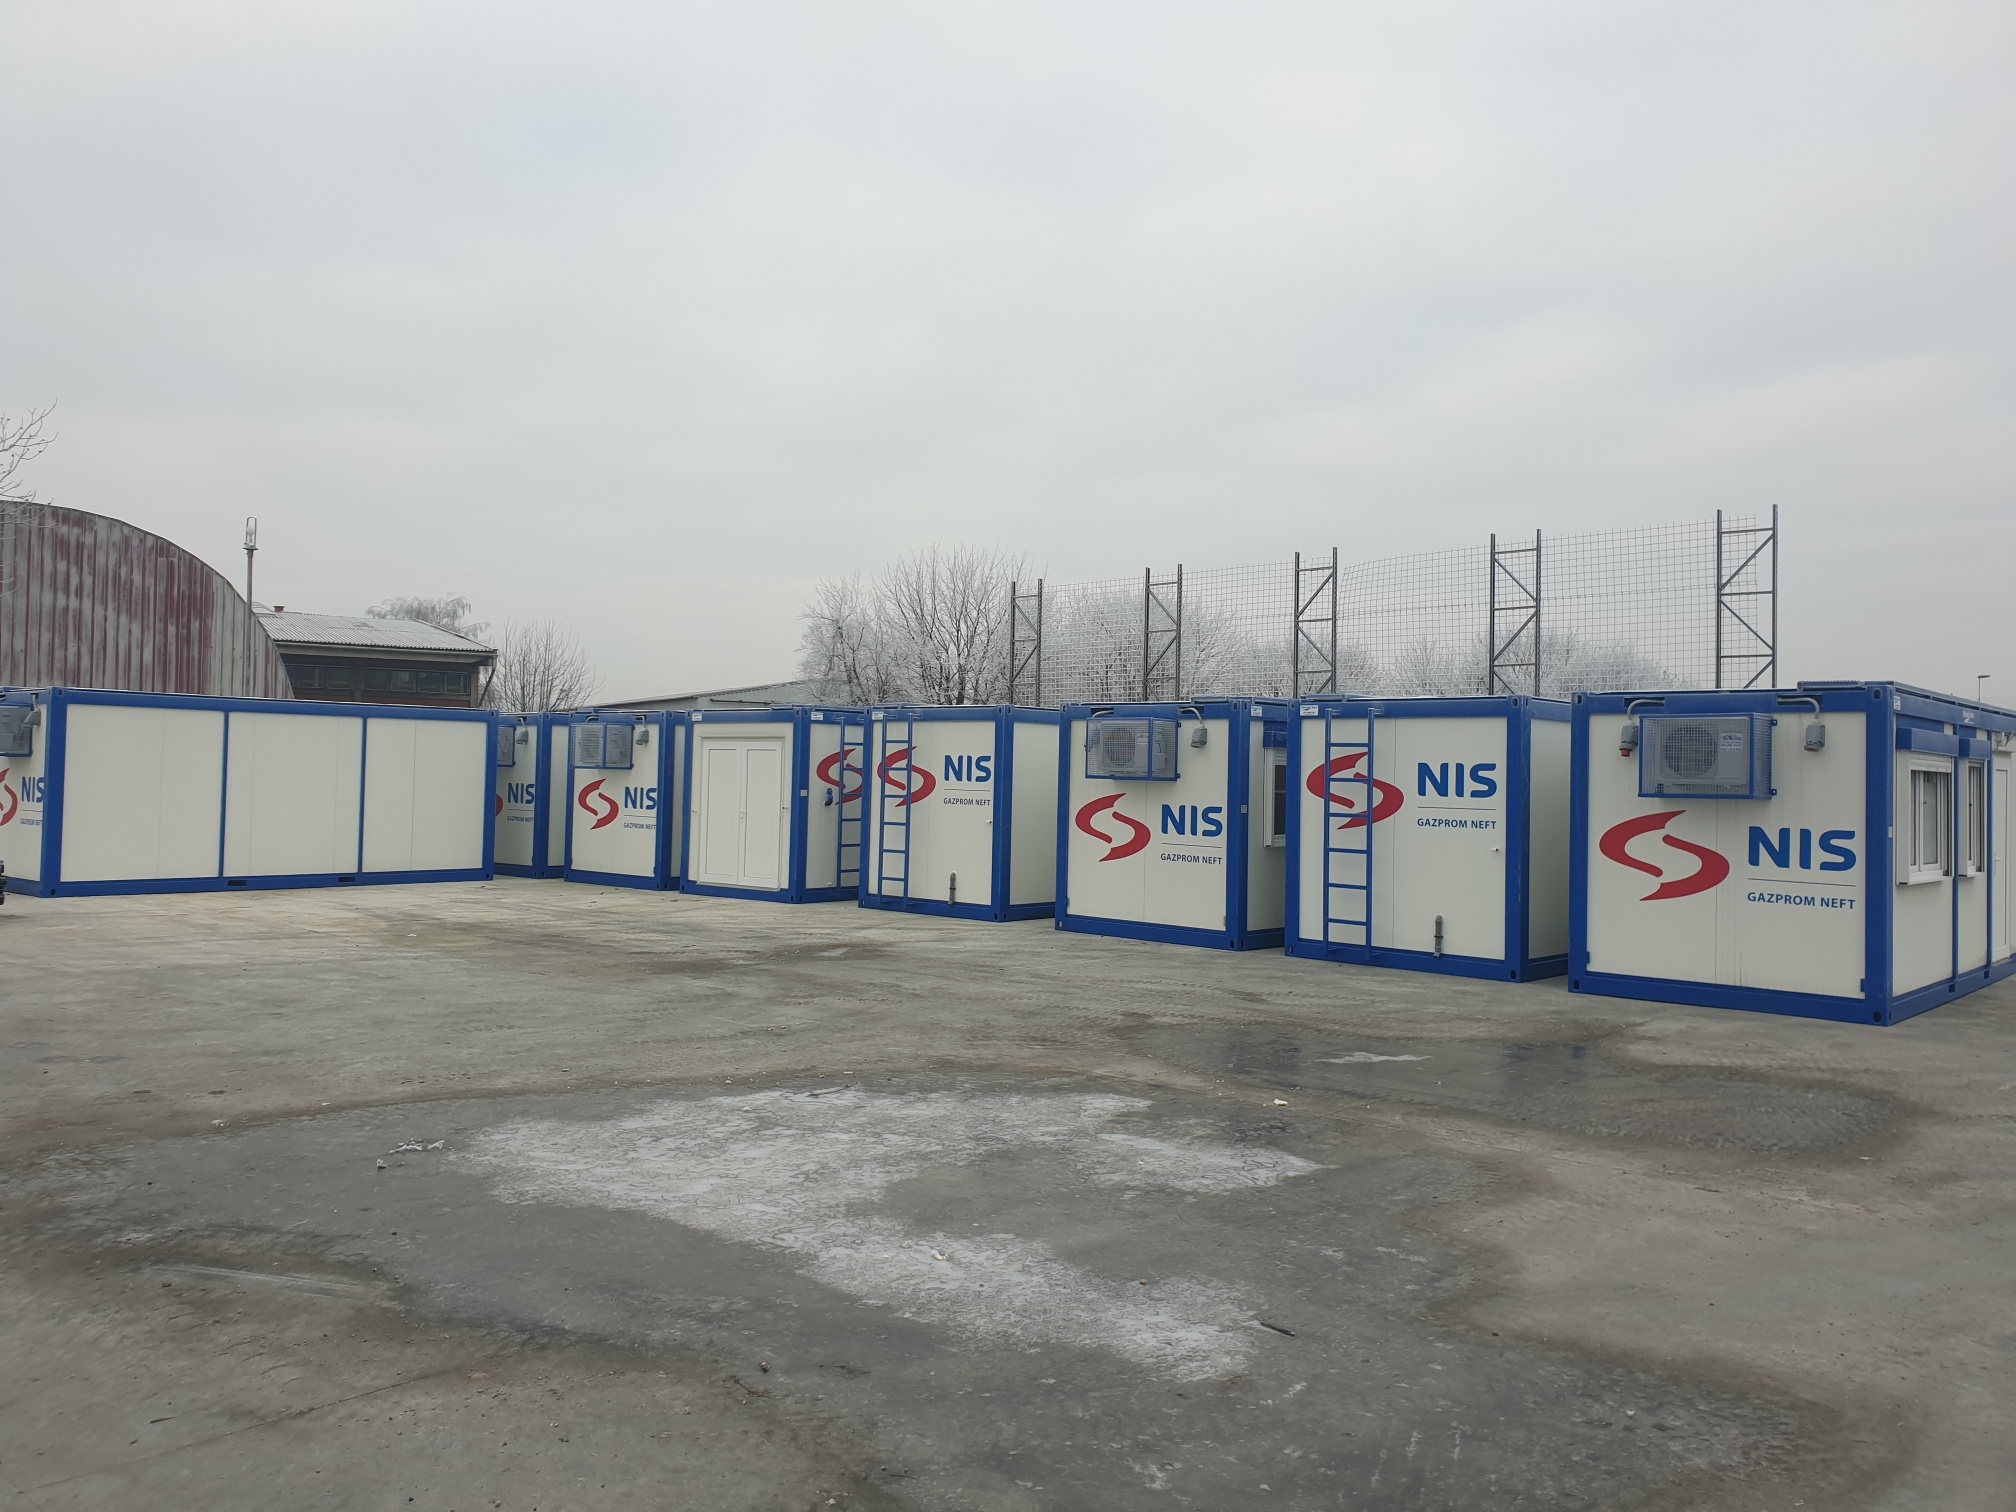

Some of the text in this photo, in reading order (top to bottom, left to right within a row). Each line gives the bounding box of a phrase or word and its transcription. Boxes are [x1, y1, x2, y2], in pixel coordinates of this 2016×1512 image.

[944, 754, 992, 783] NIS
[21, 776, 44, 803] NIS
[1417, 762, 1498, 799] NIS
[507, 782, 535, 804] NIS
[624, 786, 658, 810] NIS
[943, 797, 991, 807] GAZPROM NEFT
[623, 821, 644, 829] GAZPROM
[1160, 803, 1224, 838] NIS
[1416, 817, 1497, 830] GAZPROM NEFT
[1160, 852, 1223, 866] GAZPROM NEFT
[1747, 825, 1857, 872] NIS
[1746, 891, 1856, 910] GAZPROM NEFT
